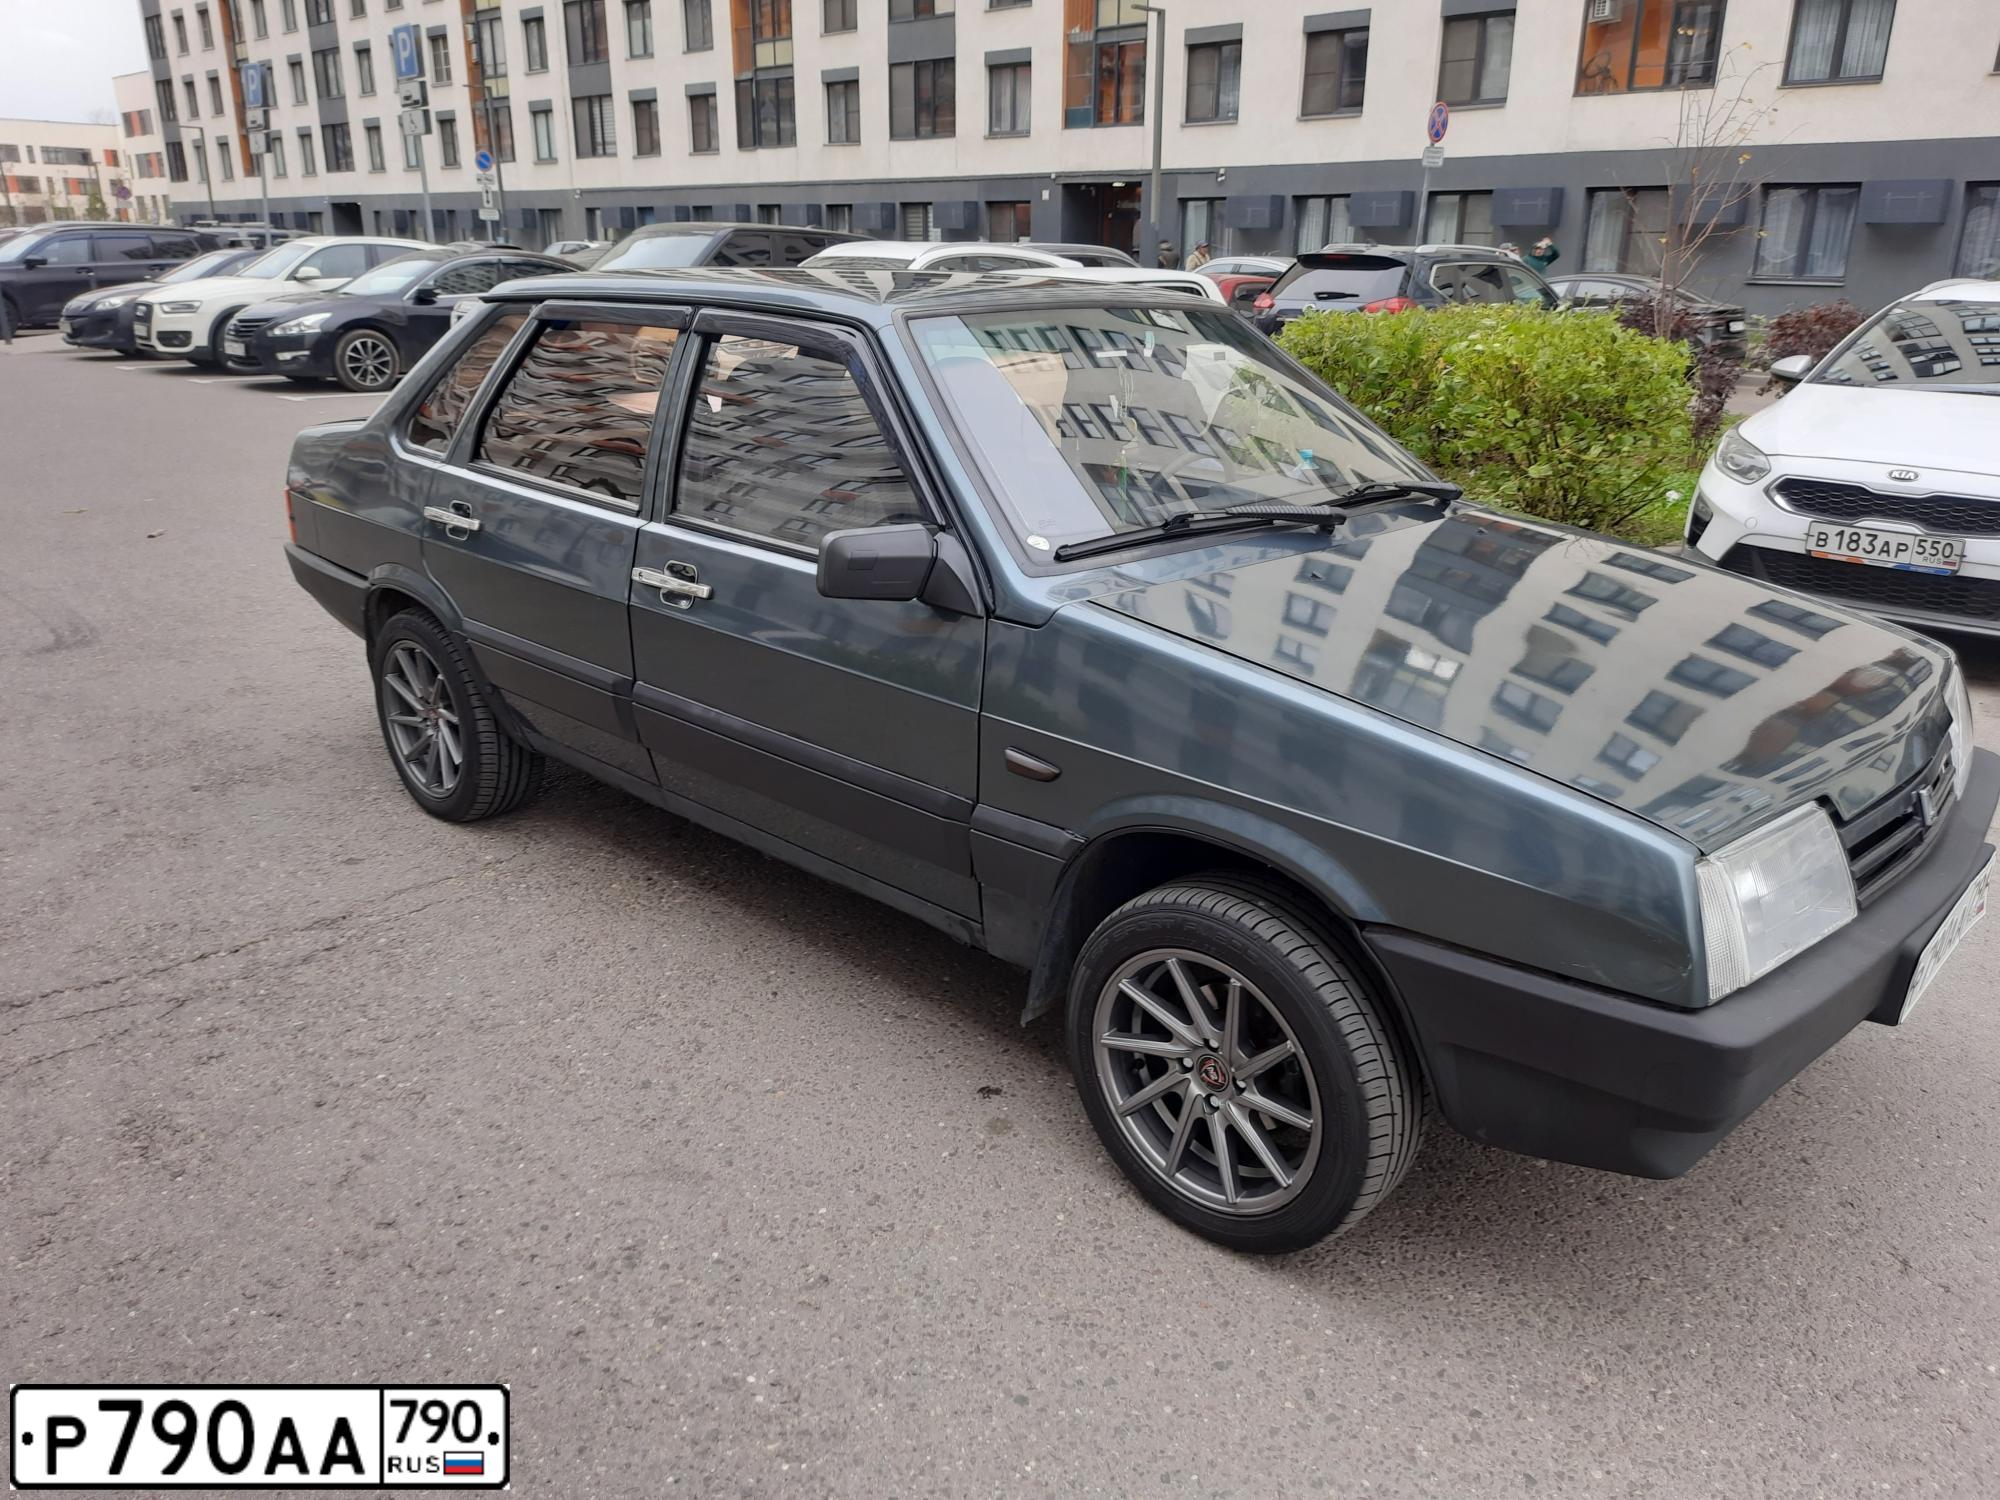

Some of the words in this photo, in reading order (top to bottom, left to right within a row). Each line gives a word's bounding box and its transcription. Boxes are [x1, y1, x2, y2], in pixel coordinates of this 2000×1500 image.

[397, 31, 411, 73] P
[247, 68, 257, 102] P
[1891, 470, 1916, 480] KIA
[1915, 538, 1954, 559] 550
[1922, 556, 1942, 565] RUS
